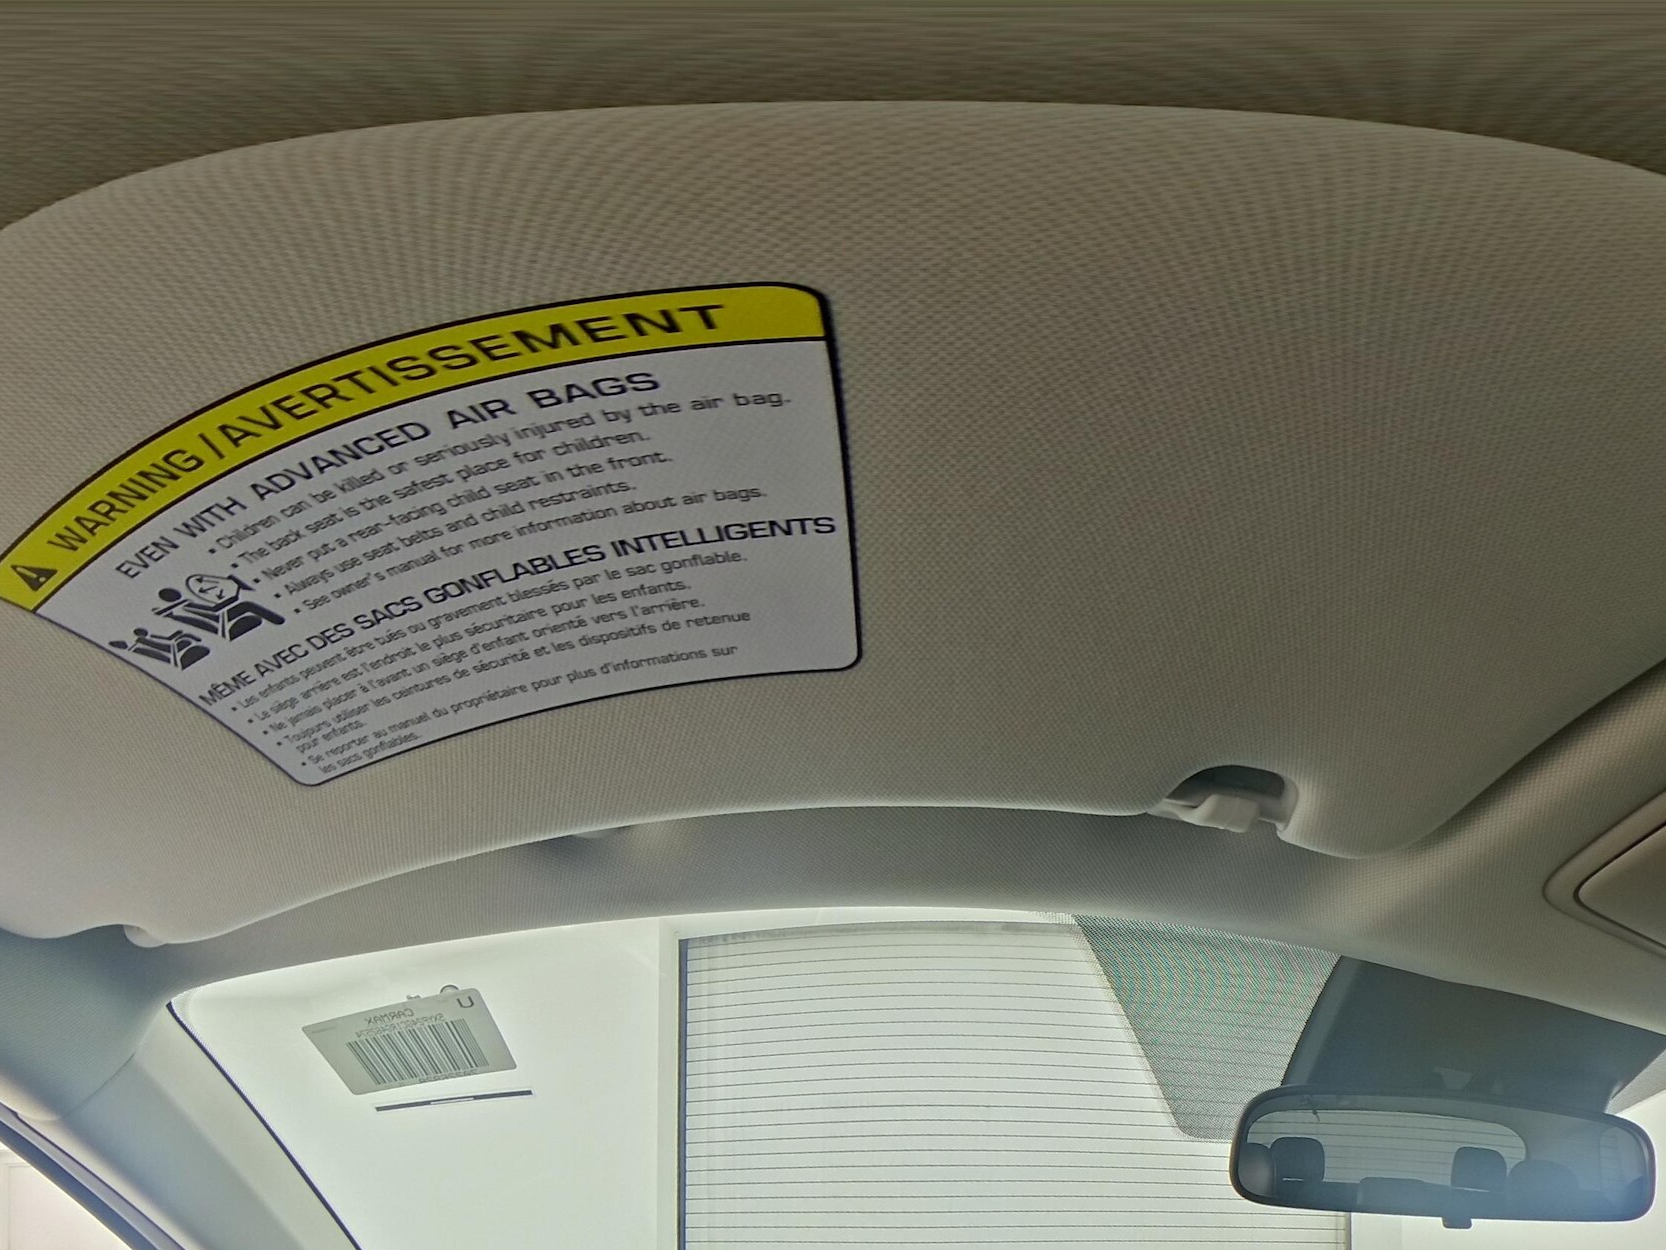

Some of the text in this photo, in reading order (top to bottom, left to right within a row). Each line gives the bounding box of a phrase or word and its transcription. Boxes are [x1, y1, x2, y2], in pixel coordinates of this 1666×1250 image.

[114, 371, 661, 580] EVEN WITH ADVANCED AIR BAGS
[214, 392, 791, 550] Children can be killed or seriously injured by the air bag.
[236, 431, 650, 564] The back seat is the safest place for children.
[260, 451, 673, 581] Never put a rear-facing child seat in the front.
[283, 481, 637, 596] Always use seat belts and child restraints.
[301, 487, 767, 611] See owner's manual for more information about air bags.
[198, 516, 837, 707] MÊME AVEC DES SACS GONFLABLES INTELLIGENTS
